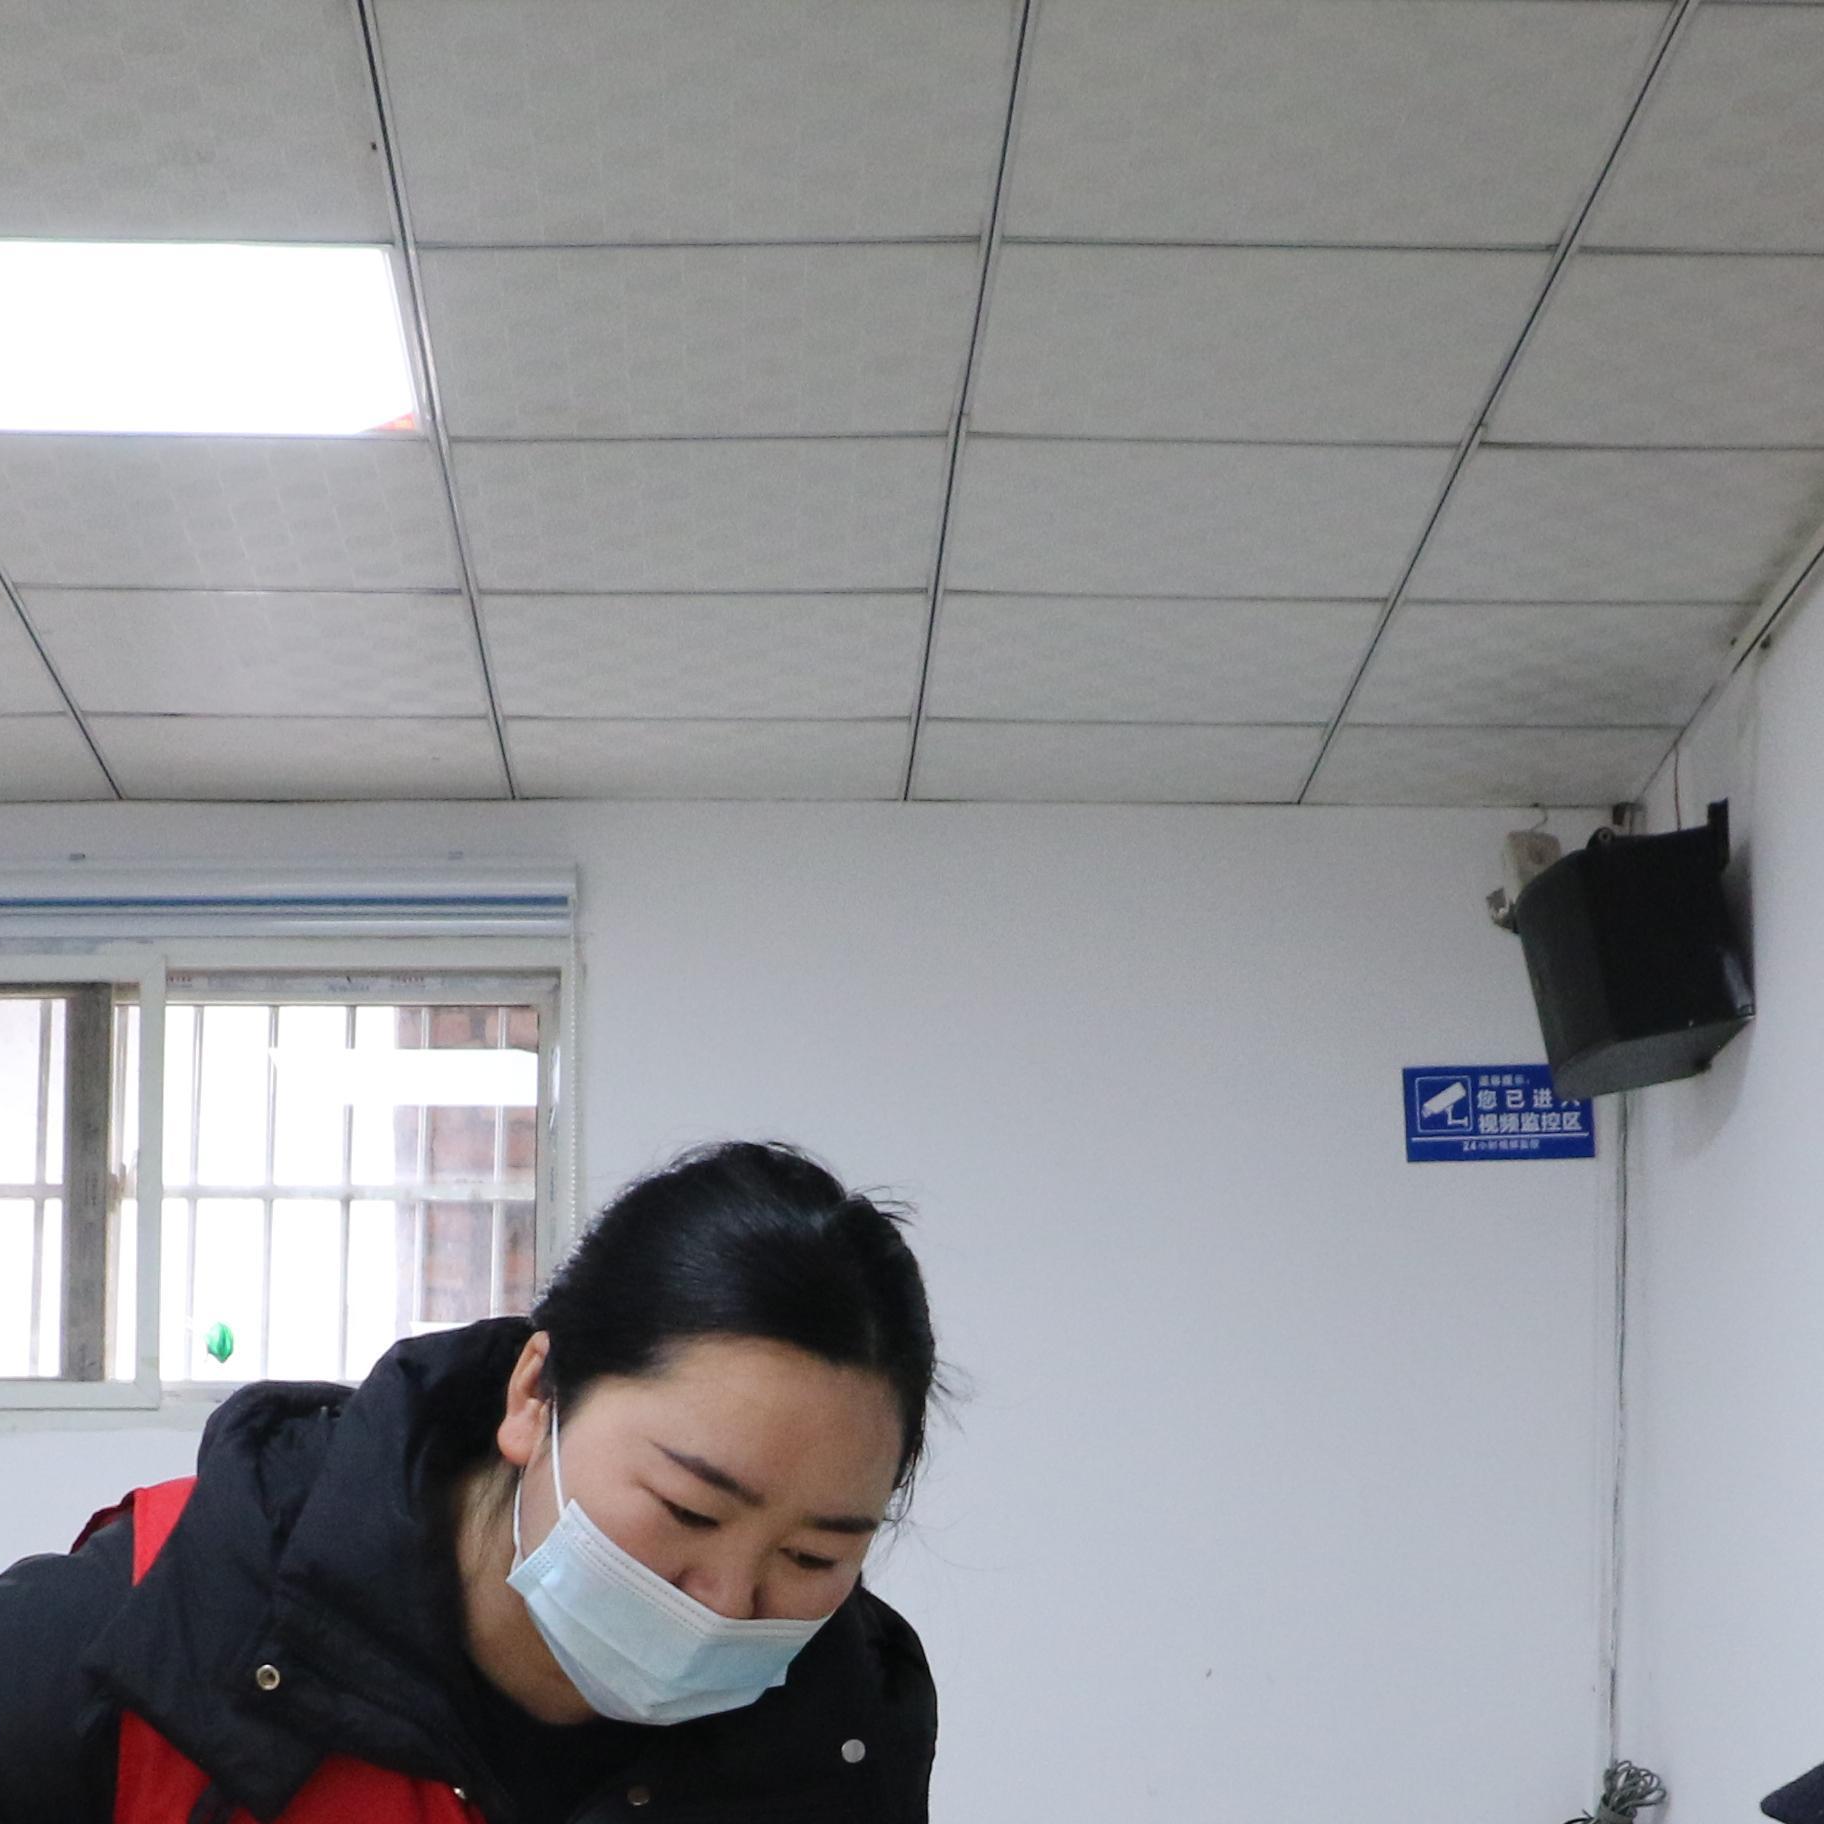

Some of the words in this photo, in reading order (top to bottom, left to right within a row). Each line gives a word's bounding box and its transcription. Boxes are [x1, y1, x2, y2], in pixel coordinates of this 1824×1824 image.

[1479, 1111, 1582, 1134] 视频监控区
